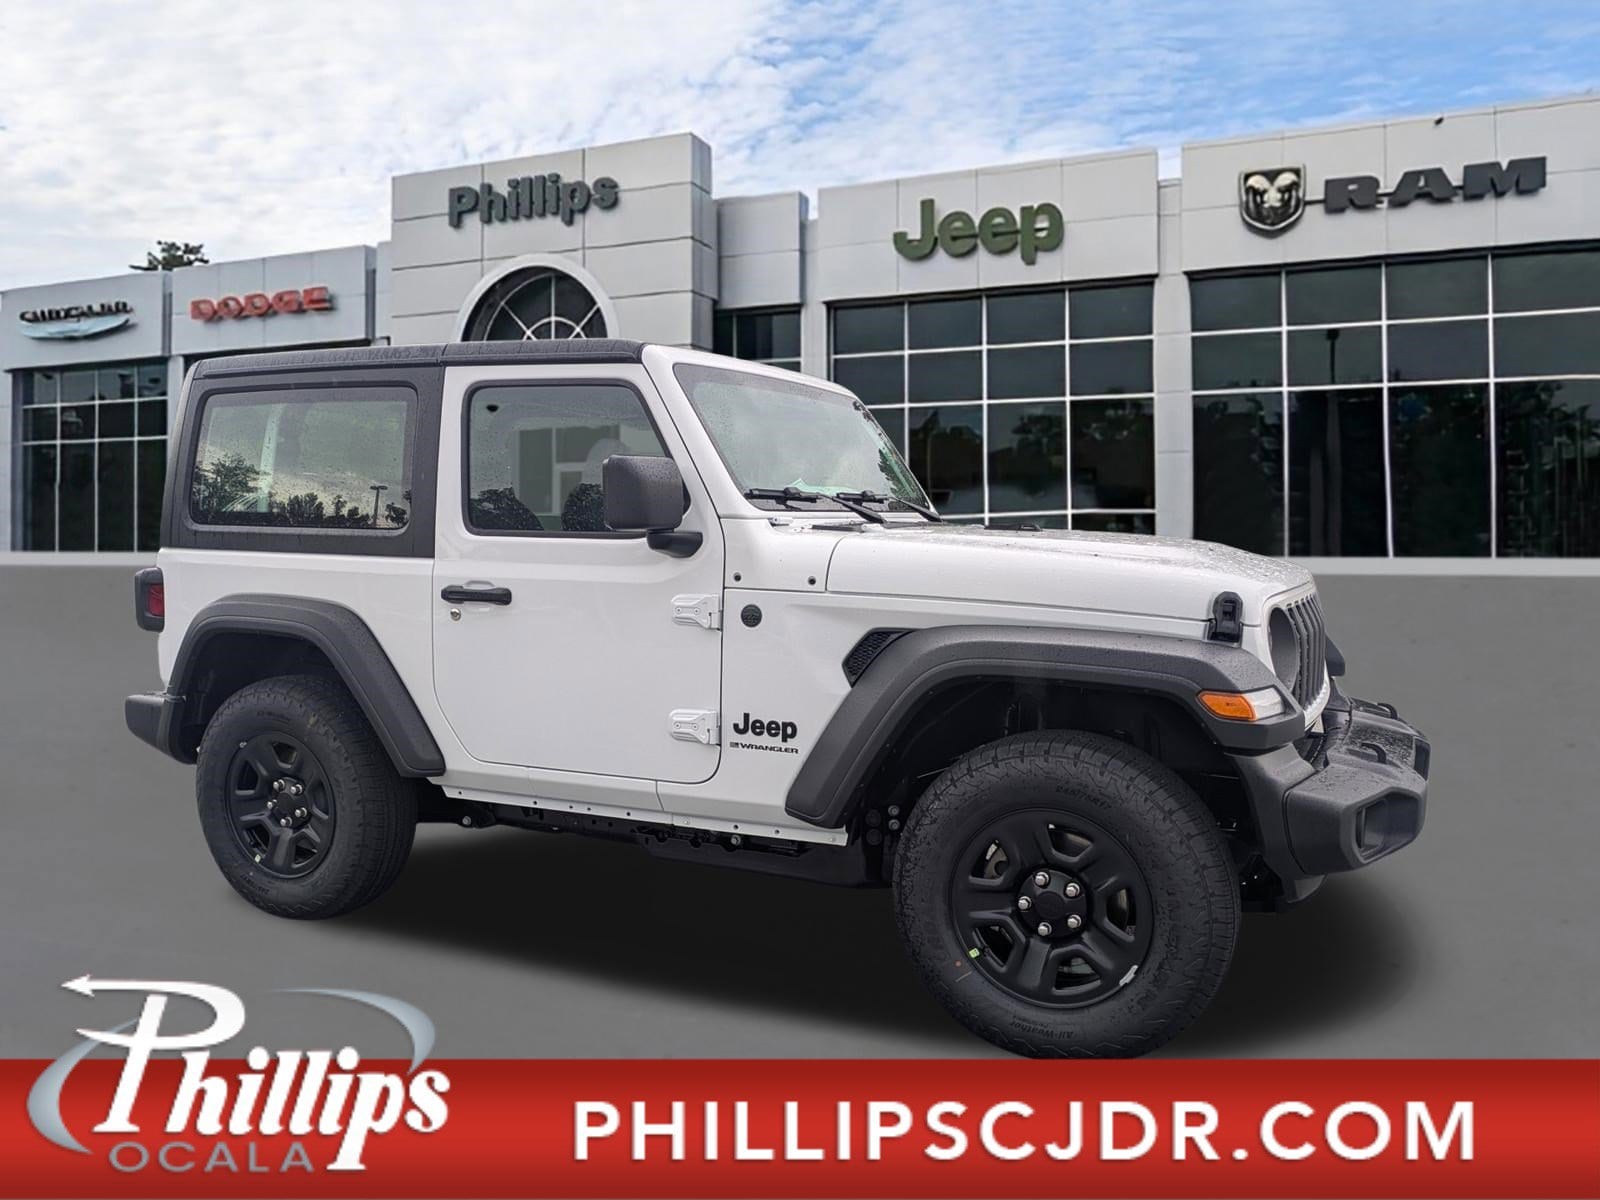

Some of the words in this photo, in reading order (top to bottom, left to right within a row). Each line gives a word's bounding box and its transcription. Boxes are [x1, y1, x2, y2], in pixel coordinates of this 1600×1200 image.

[448, 173, 619, 229] Phillips
[1324, 156, 1547, 213] RAM
[893, 198, 1064, 265] Jeep
[190, 286, 332, 321] DODGE
[733, 712, 797, 742] Jeep
[740, 742, 799, 754] WRANGLER
